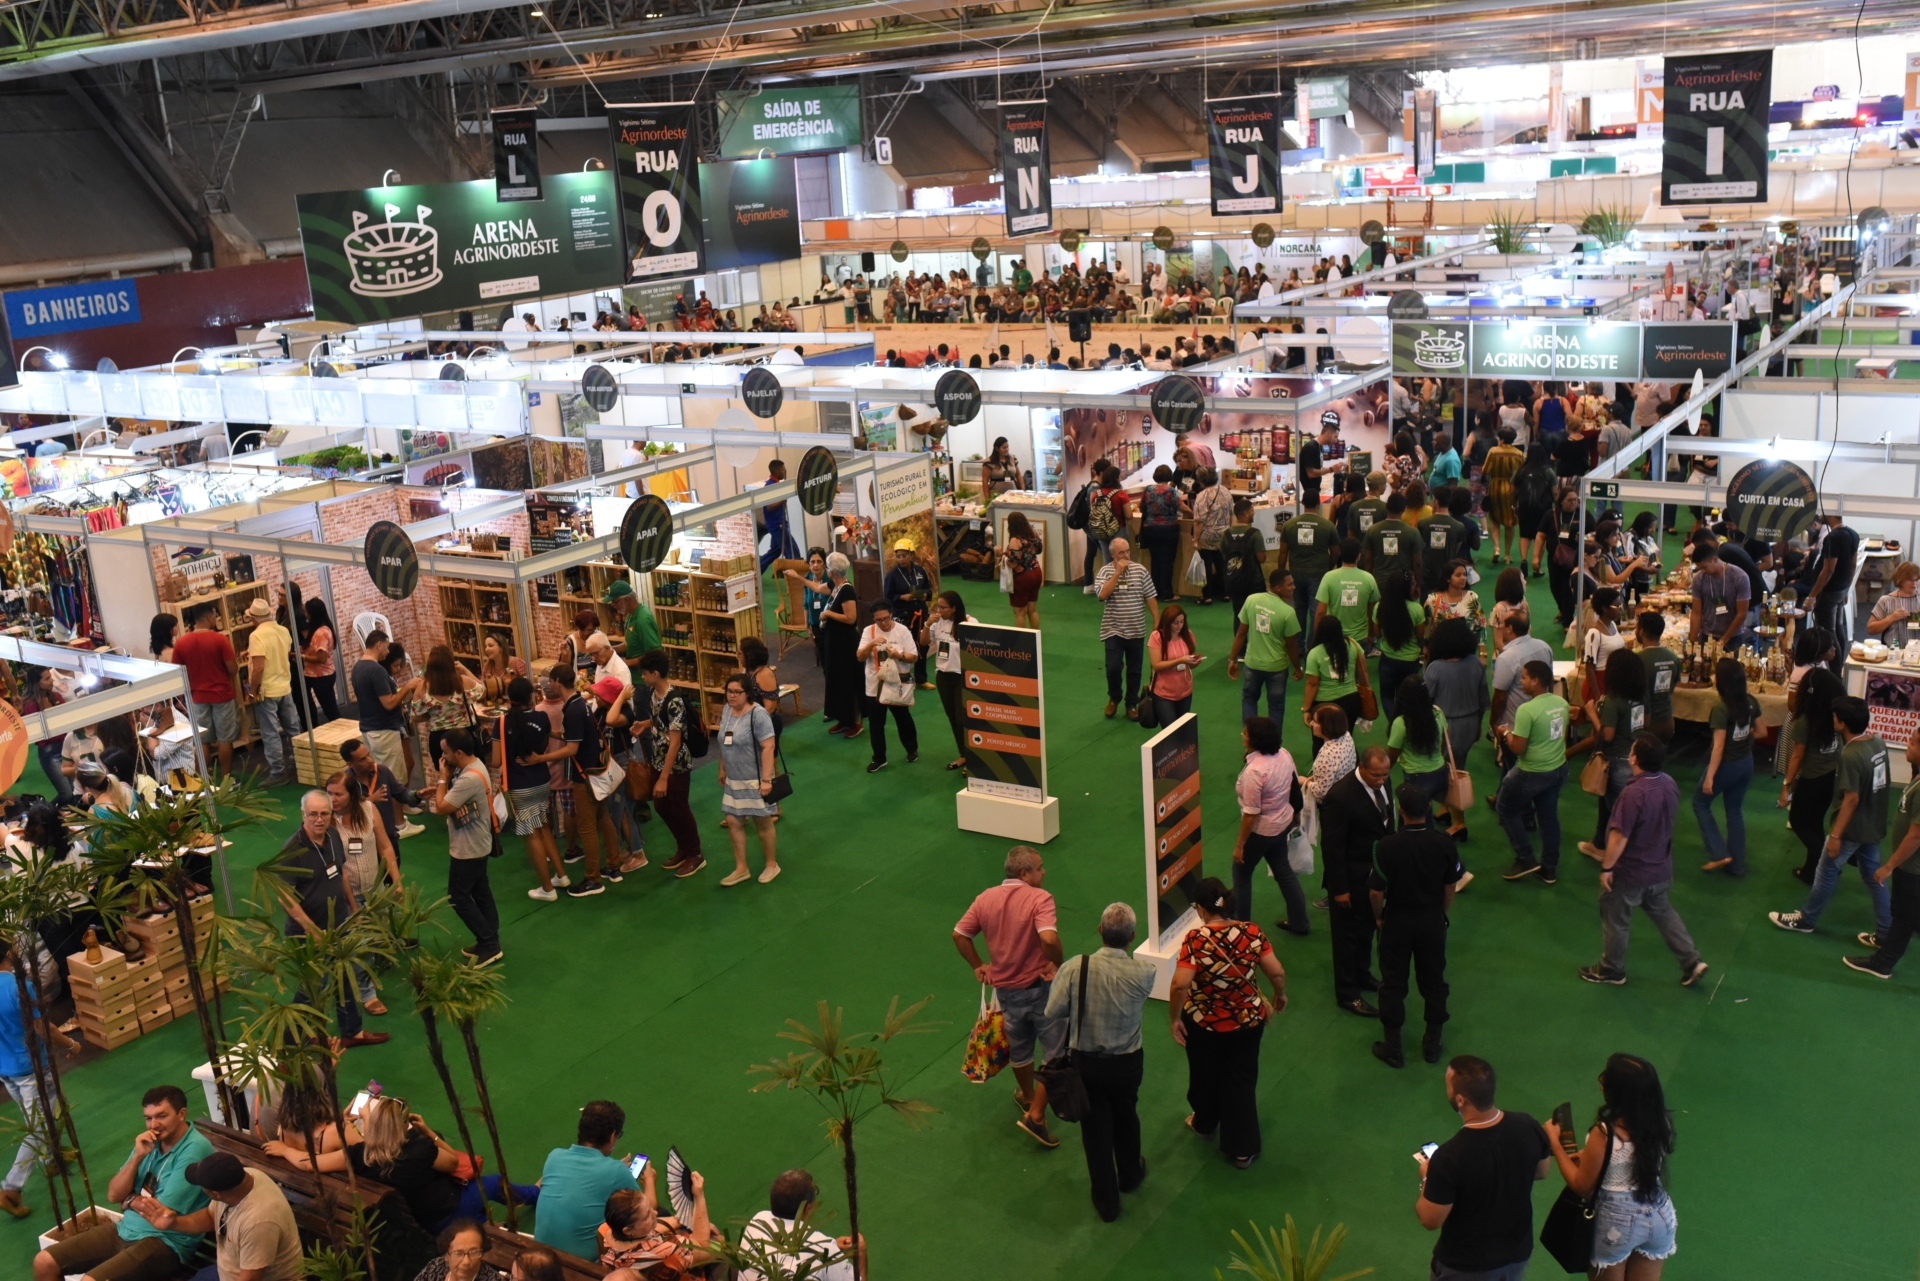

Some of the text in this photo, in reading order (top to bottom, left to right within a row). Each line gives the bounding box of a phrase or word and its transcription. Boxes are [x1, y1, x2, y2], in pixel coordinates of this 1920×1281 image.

[1674, 69, 1762, 88] Agrinordeste
[763, 99, 821, 119] SAÍDA DE
[1689, 90, 1746, 112] RUA
[1213, 111, 1273, 127] Agrinordeste
[620, 126, 688, 145] Agrinordeste
[753, 118, 834, 140] EMERGÊNCIA
[1225, 127, 1264, 144] RUA
[503, 133, 527, 146] RUA
[1014, 136, 1039, 154] RUA
[879, 140, 889, 161] G
[1705, 126, 1725, 176] I
[507, 154, 526, 184] L
[635, 149, 679, 174] RUA
[1232, 154, 1259, 194] J
[1017, 166, 1040, 210] N
[736, 207, 789, 226] Agrinordeste
[472, 218, 539, 246] ARENA
[453, 238, 560, 266] AGRINORDESTE
[1279, 244, 1322, 254] NORCANA
[23, 291, 131, 326] BANHEIROS
[1519, 334, 1581, 351] ARENA
[1483, 352, 1619, 370] AGRINORDESTE
[1655, 350, 1727, 362] Agrinordeste
[747, 389, 778, 398] PAJELAT
[943, 392, 973, 401] ASPOM
[1157, 400, 1198, 409] Café Caramello
[803, 472, 833, 490] APETURR
[879, 468, 927, 492] TURISMO RURAL E
[880, 480, 928, 503] ECOLÓGICO EM
[1738, 493, 1805, 508] CURTA EM CASA
[882, 491, 929, 520] Pernambuco
[636, 526, 658, 541] APAR
[381, 556, 402, 567] APAR
[964, 637, 1001, 647] Vigésimo Sétimo
[965, 644, 1033, 662] Agrinordeste
[984, 678, 1017, 689] AUDITÓRIOS
[985, 705, 1017, 715] BRASIL MAIS
[985, 712, 1023, 722] COOPERATIVO
[1869, 706, 1907, 718] QUEIJO
[1873, 715, 1917, 728] COALHO
[986, 738, 1027, 749] POSTO MÉDICO
[1157, 743, 1196, 779] Agrinordeste
